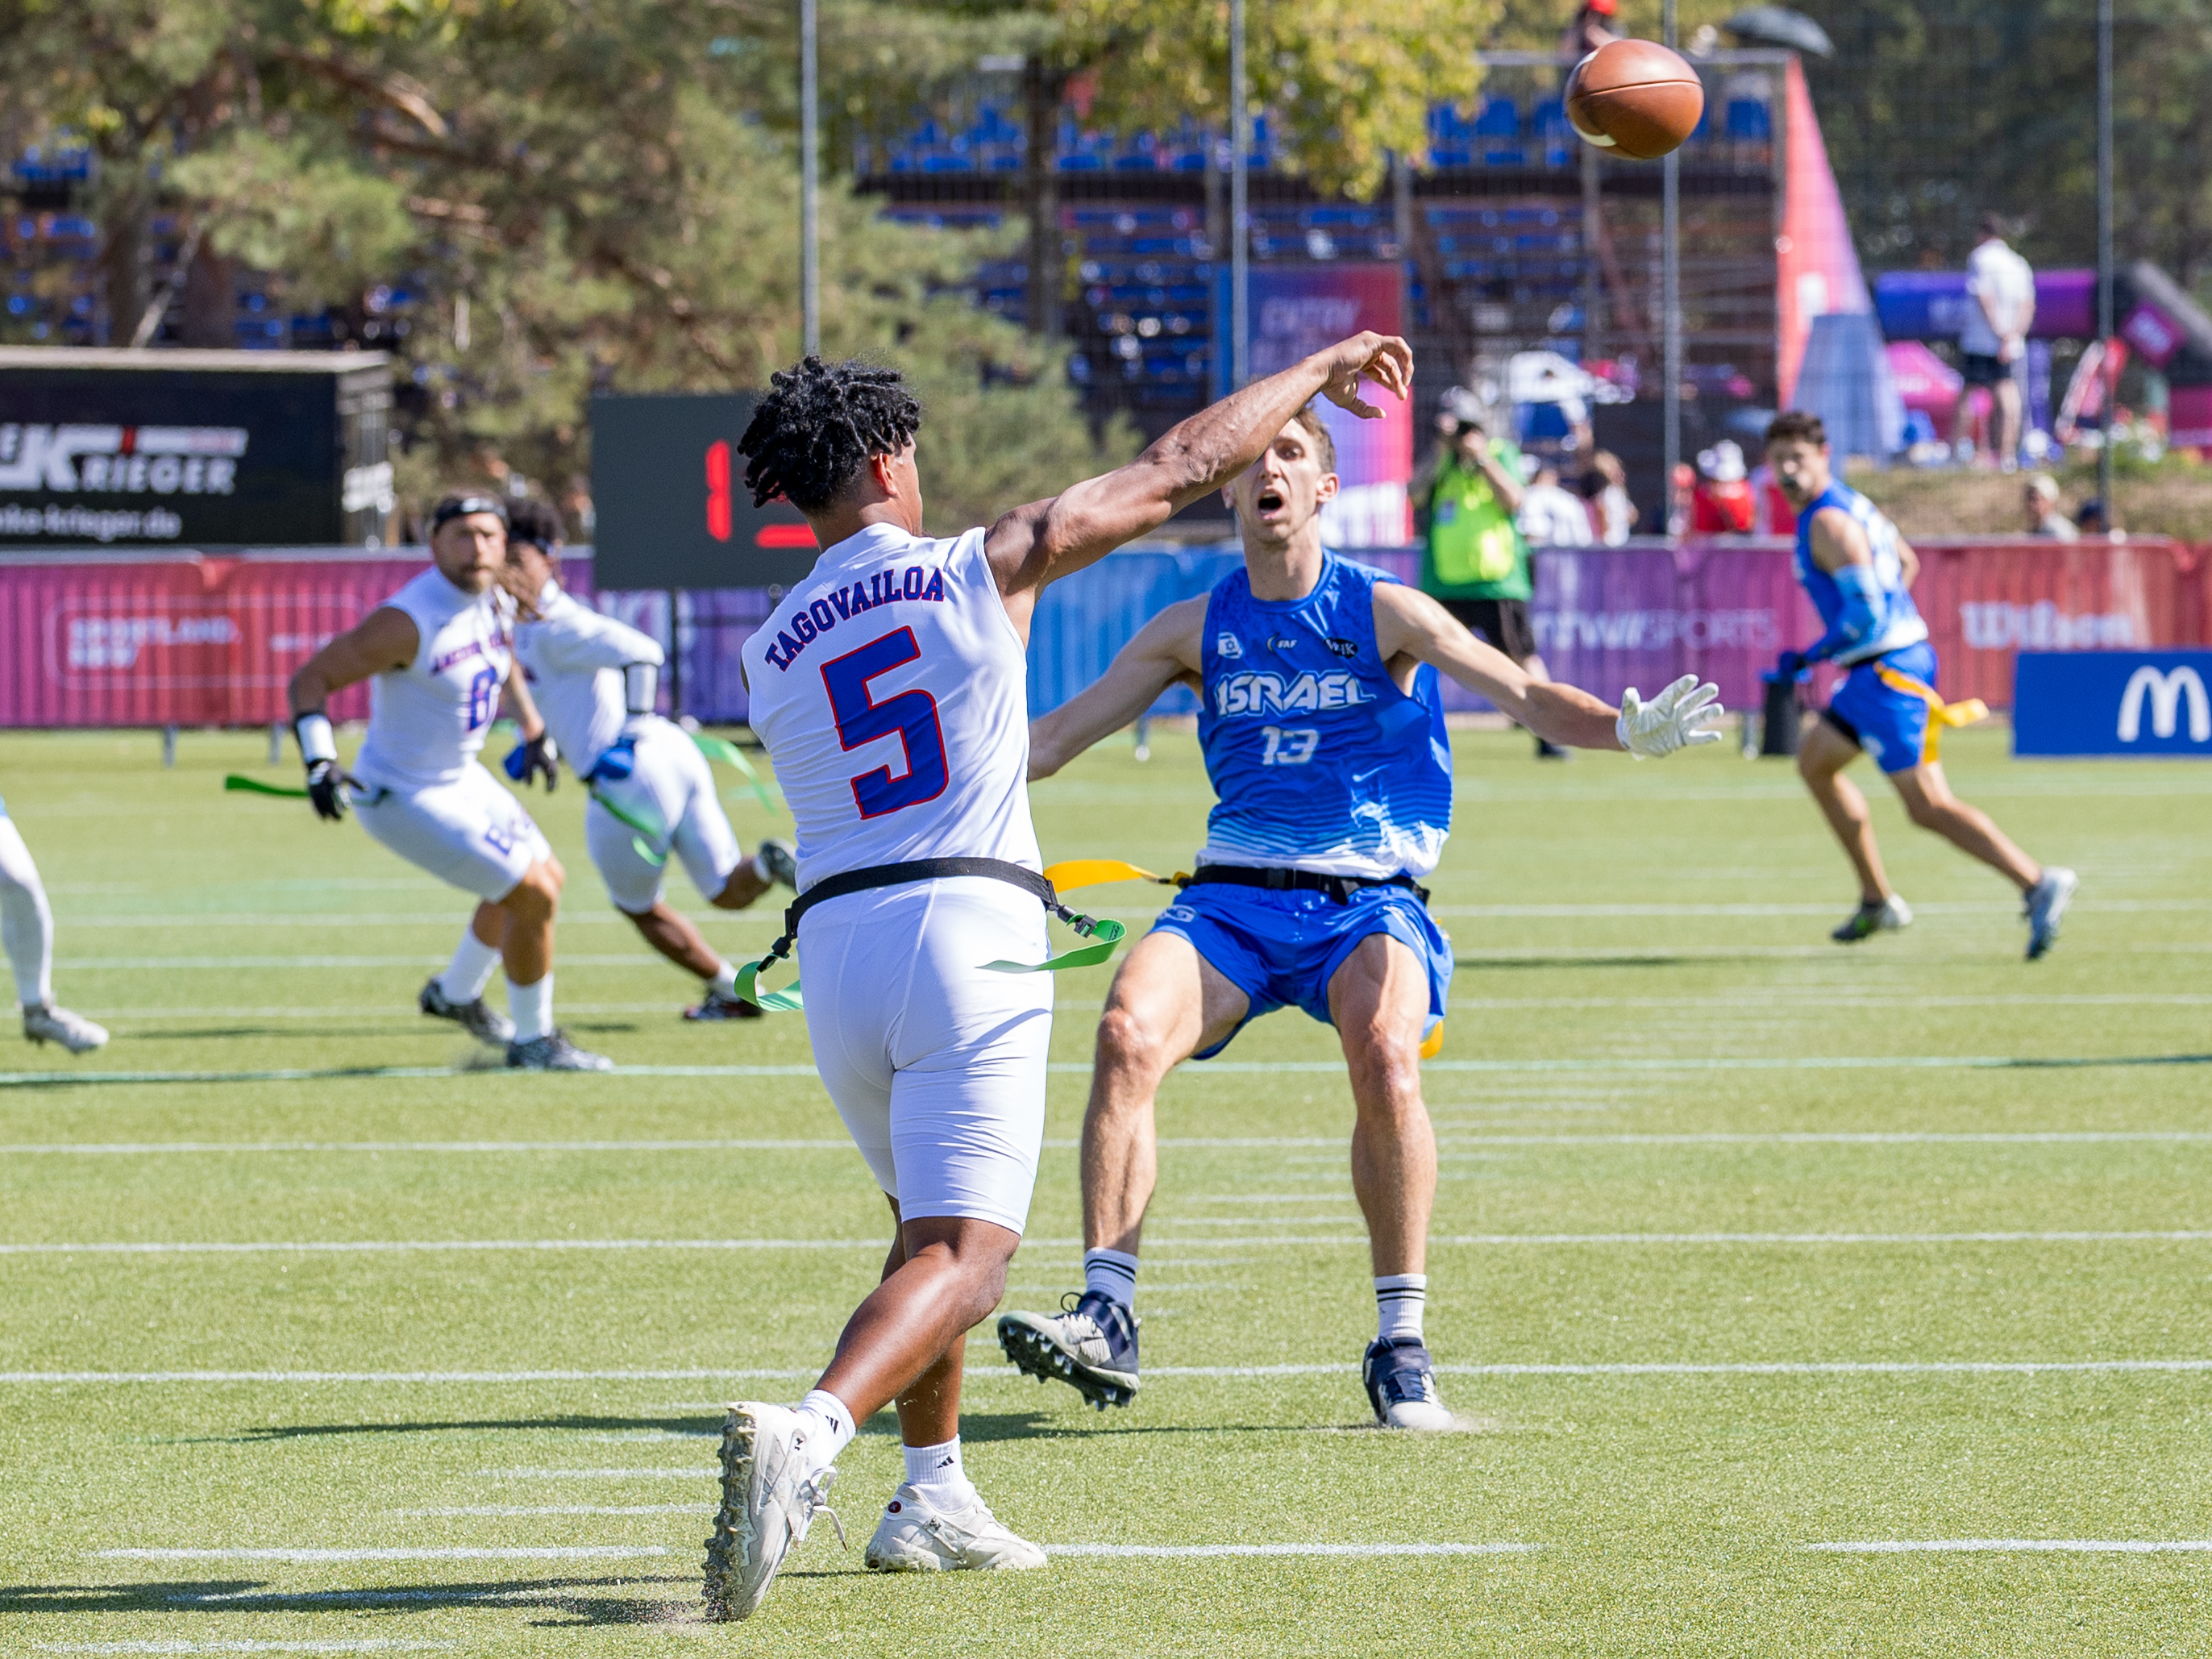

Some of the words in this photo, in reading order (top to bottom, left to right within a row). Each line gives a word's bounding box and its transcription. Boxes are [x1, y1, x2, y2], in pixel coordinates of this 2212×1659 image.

[764, 566, 945, 672] TAGOVAILOA
[820, 626, 950, 821] 5
[1215, 668, 1376, 718] ISRAEL
[1261, 726, 1320, 766] 13
